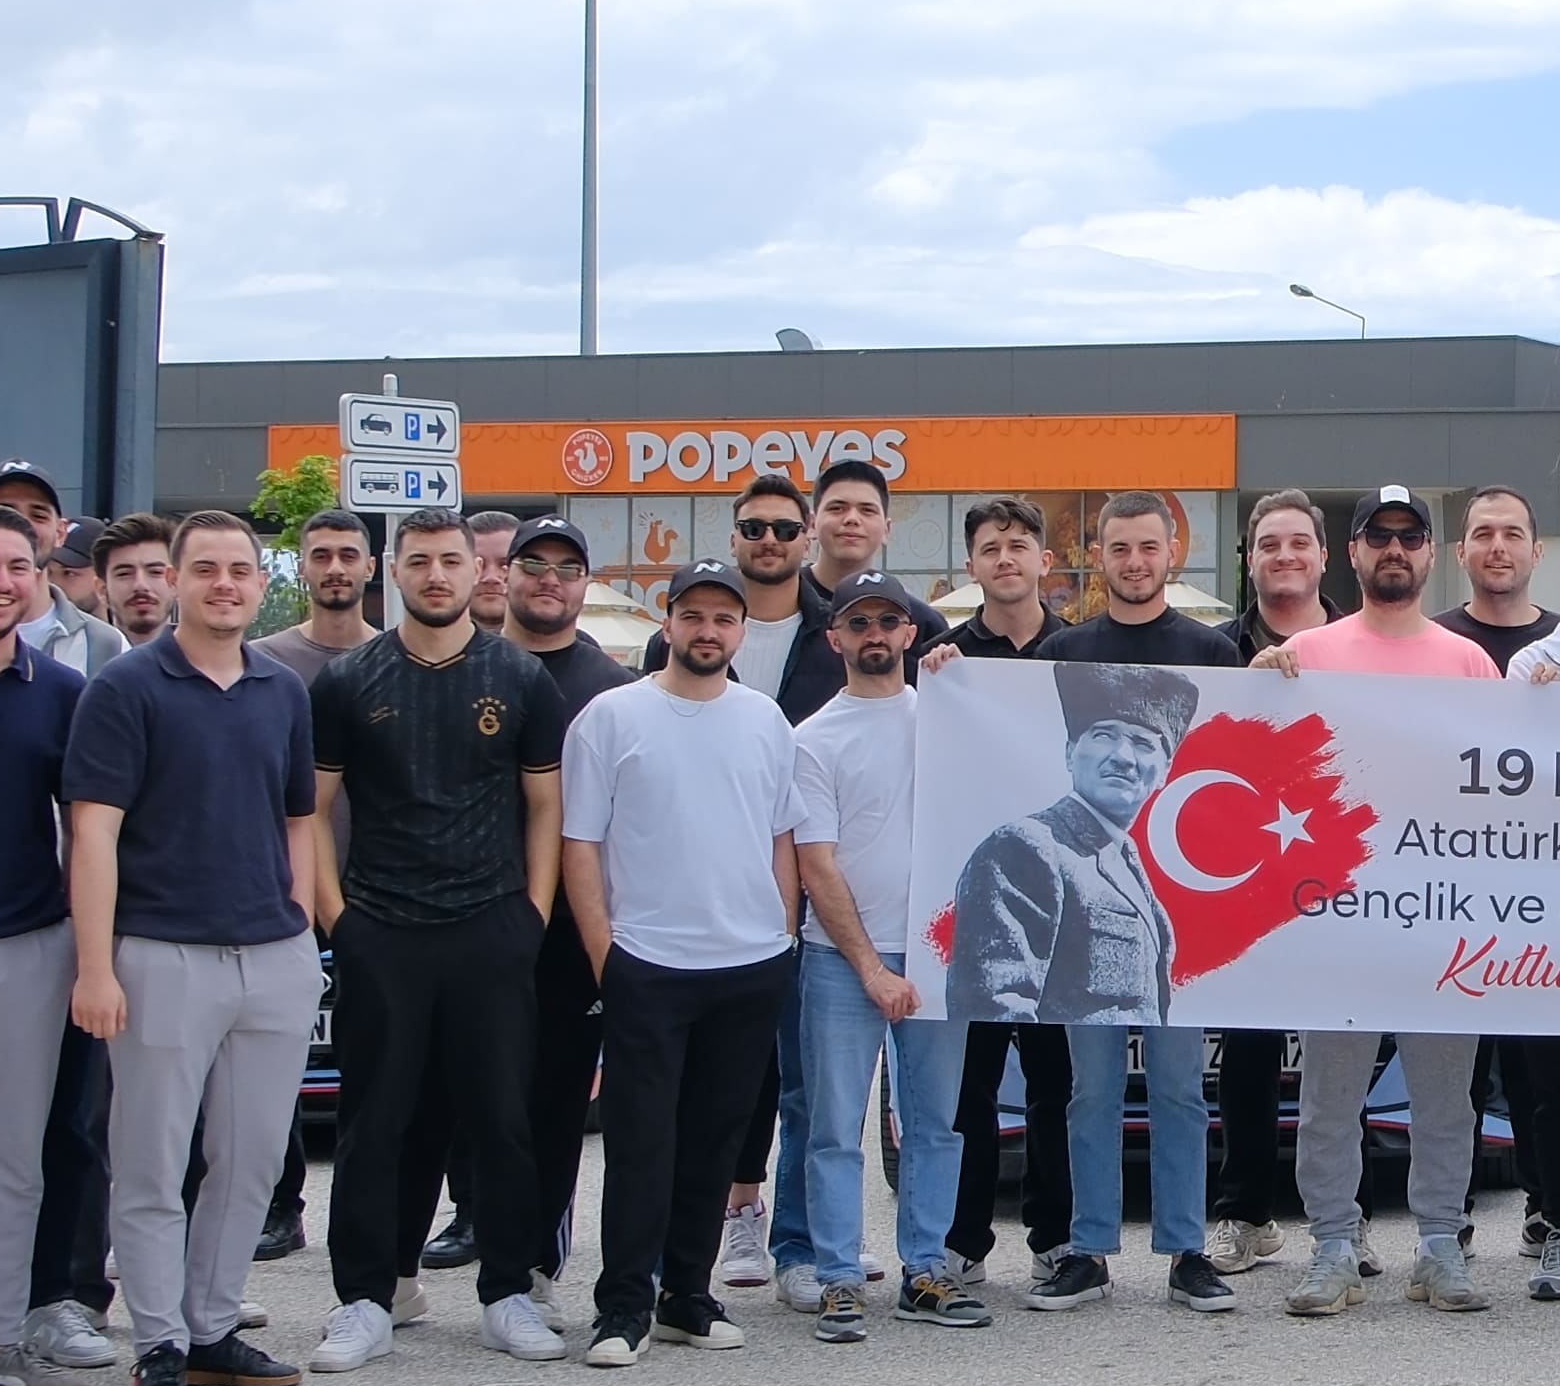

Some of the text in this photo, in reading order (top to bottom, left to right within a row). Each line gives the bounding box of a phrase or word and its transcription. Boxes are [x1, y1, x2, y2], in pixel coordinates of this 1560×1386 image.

[407, 415, 418, 439] P
[408, 474, 418, 497] P
[1458, 746, 1535, 797] 19
[1291, 878, 1476, 929] Gençlik
[1488, 894, 1546, 925] ve
